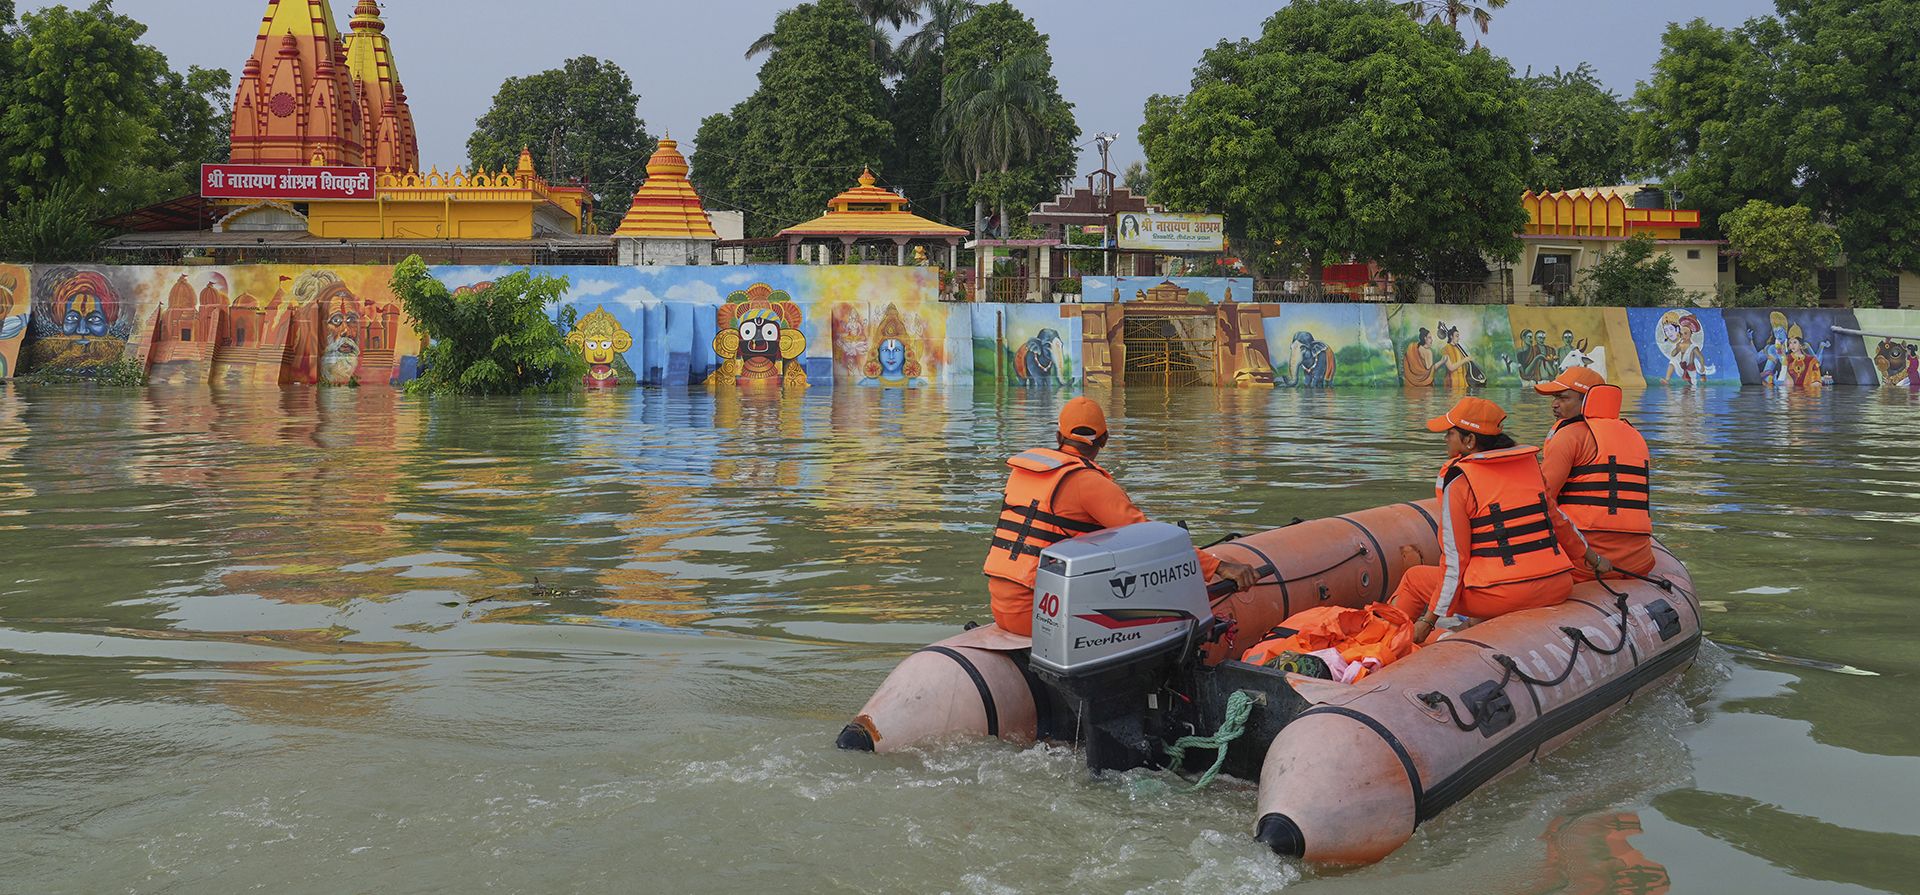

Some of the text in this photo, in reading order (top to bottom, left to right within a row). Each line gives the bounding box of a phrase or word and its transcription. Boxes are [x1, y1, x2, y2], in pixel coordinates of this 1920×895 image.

[207, 169, 370, 195] श्री नारायण आश्रम शिवकुटी
[1141, 218, 1220, 233] श्री नारायण आश्रम
[1140, 559, 1197, 588] TOHATSU
[1038, 592, 1060, 618] 40
[1073, 631, 1142, 650] EverRun
